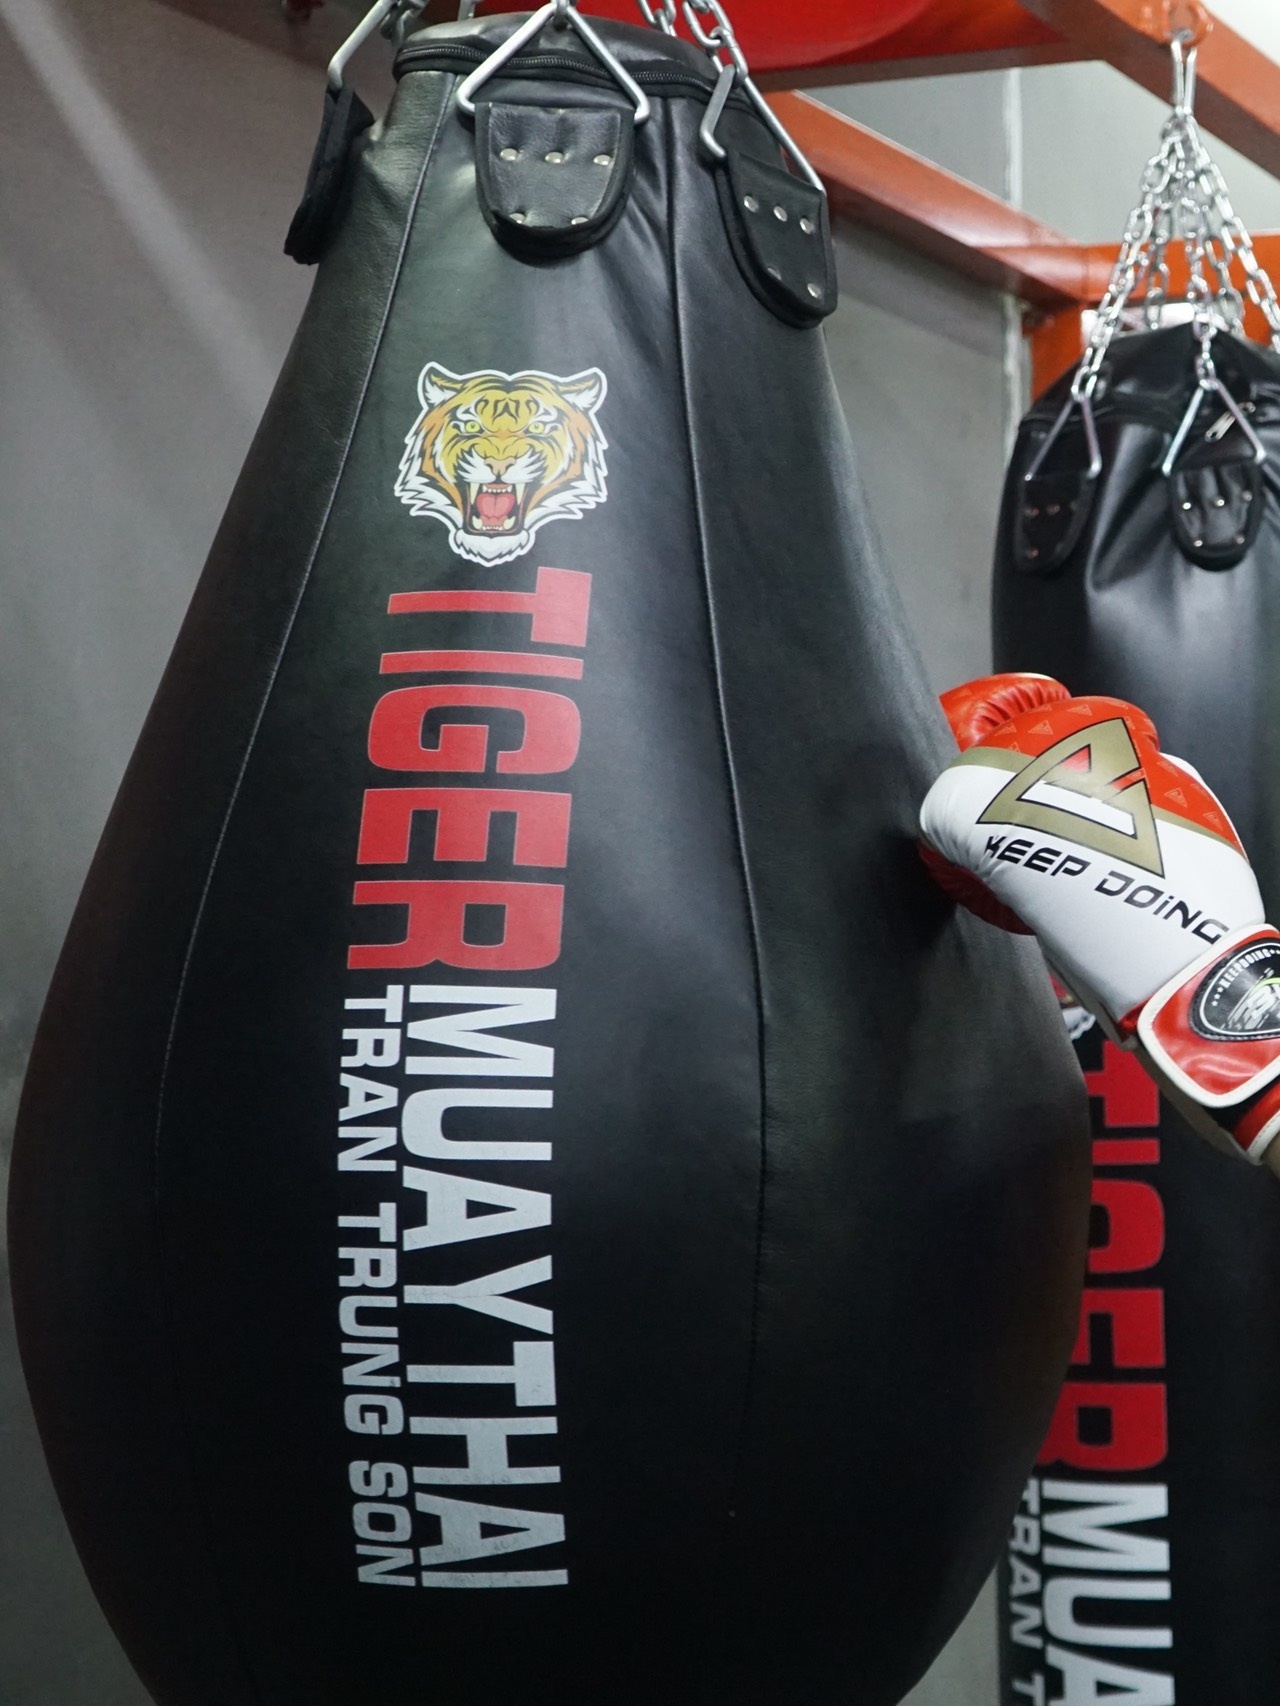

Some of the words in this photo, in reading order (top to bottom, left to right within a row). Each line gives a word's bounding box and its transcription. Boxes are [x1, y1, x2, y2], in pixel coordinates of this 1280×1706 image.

[347, 566, 592, 971] TIGER
[985, 835, 1091, 877] KEEP
[337, 984, 404, 1172] TRAN
[337, 1202, 405, 1436] TRUNG
[401, 984, 569, 1588] MUAYTHAI
[347, 1459, 417, 1587] SON
[1008, 1478, 1043, 1649] TRAN
